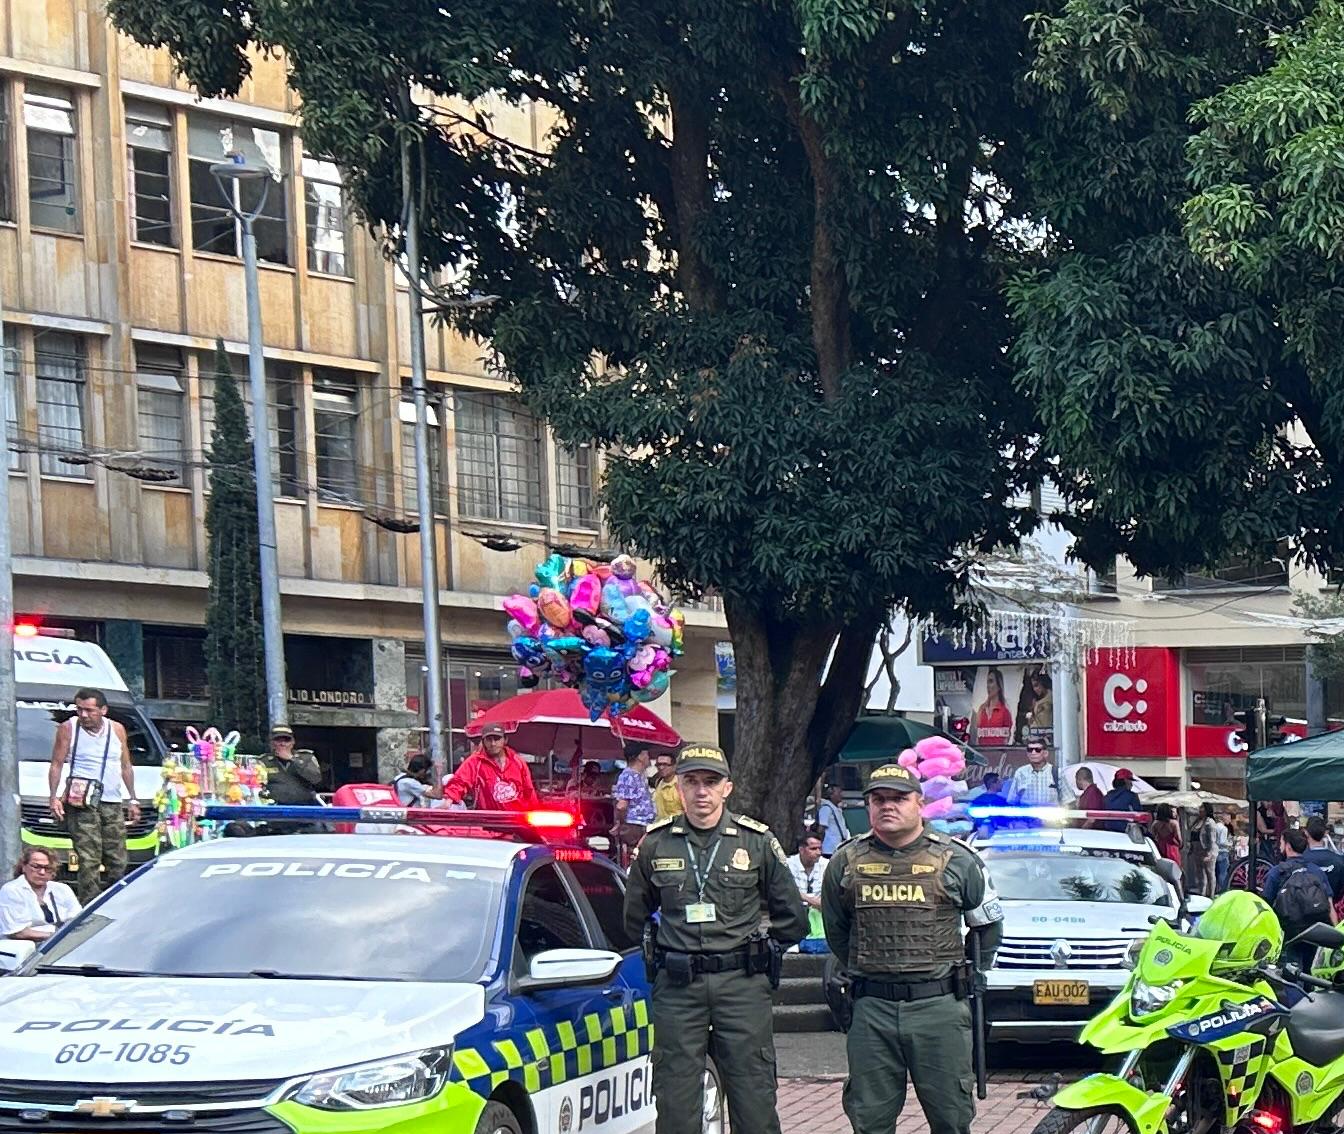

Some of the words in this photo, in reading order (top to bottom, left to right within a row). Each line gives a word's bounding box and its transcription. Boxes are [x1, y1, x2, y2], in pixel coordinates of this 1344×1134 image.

[14, 649, 92, 669] ICÍA
[201, 861, 431, 883] POLICÍA
[861, 884, 926, 902] POLICIA
[13, 1018, 276, 1036] POLICÍA
[55, 1042, 196, 1065] 60-1085
[578, 1054, 654, 1132] POLICÍ
